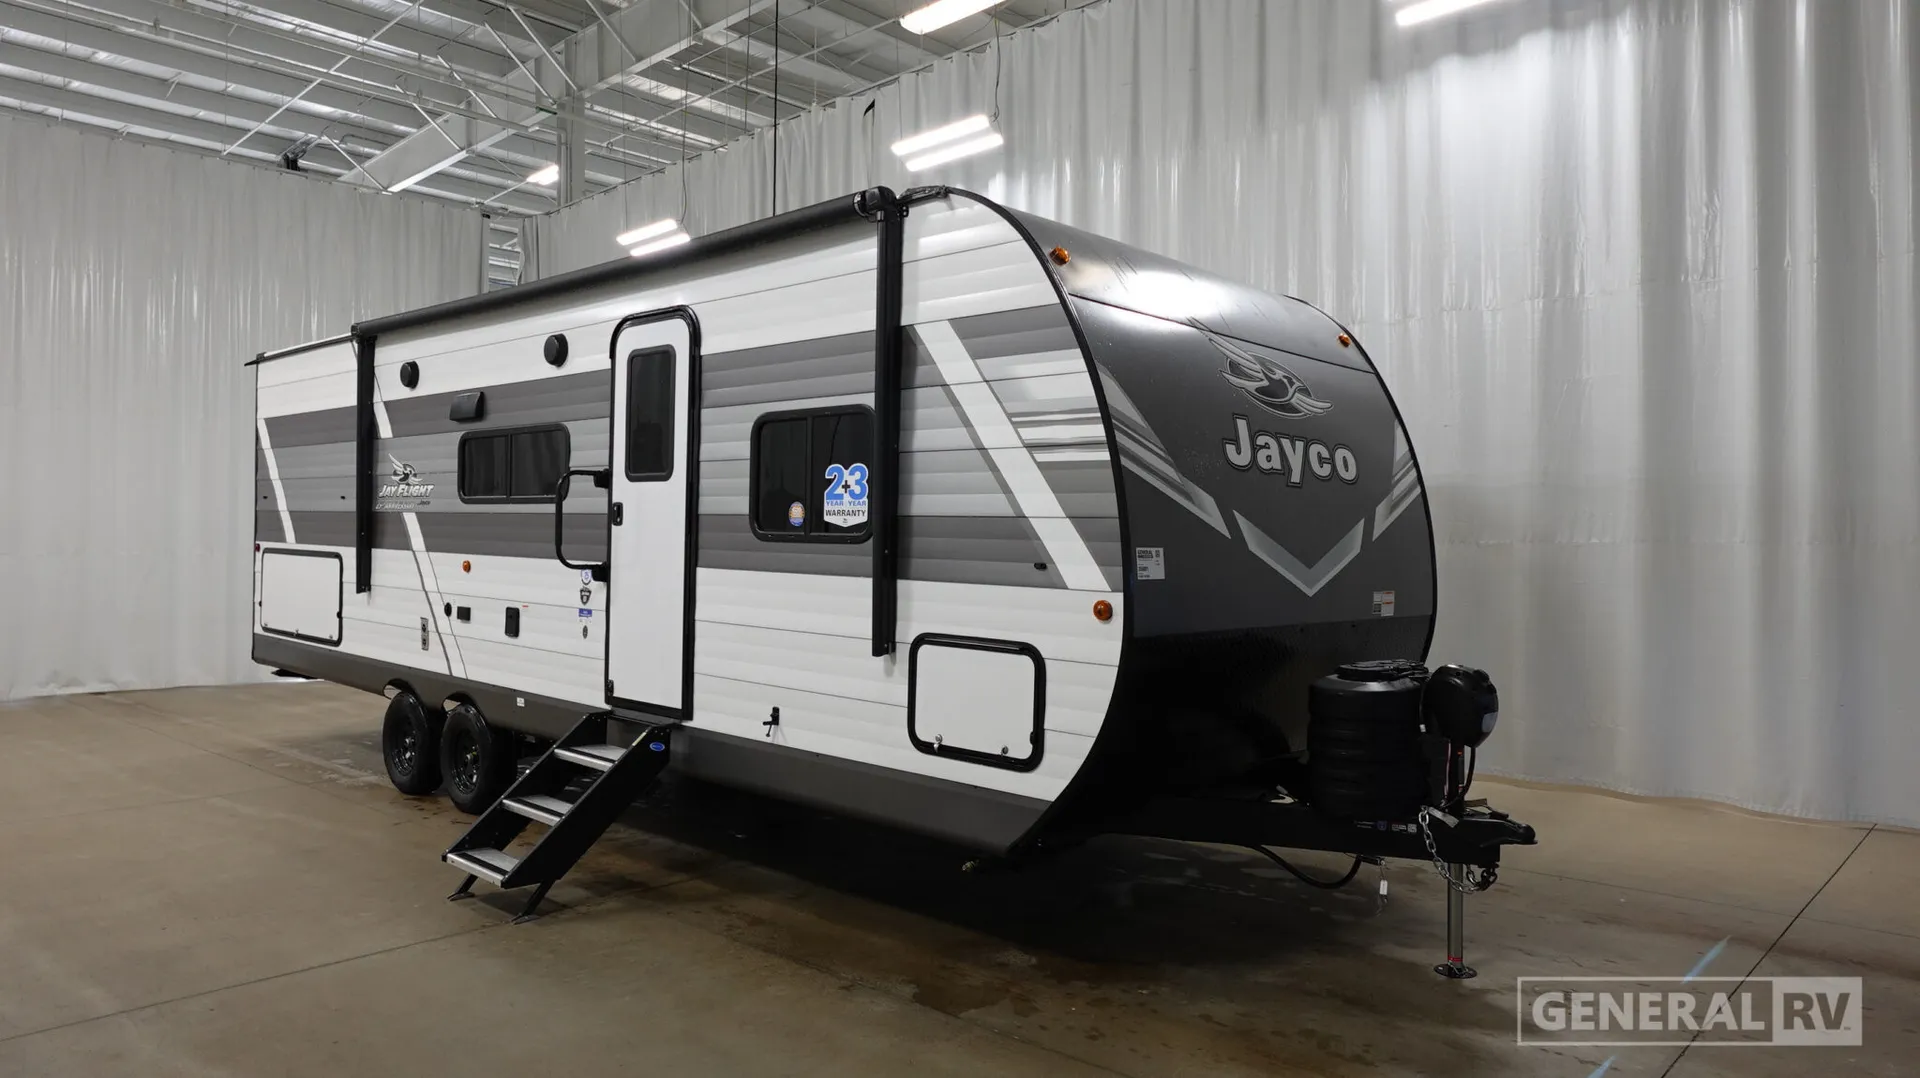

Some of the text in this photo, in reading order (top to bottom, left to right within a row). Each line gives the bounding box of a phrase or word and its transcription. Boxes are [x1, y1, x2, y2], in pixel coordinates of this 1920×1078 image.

[1224, 416, 1358, 486] Jayco
[379, 484, 434, 498] JAY FLIGHT
[825, 509, 867, 517] WARRANTY
